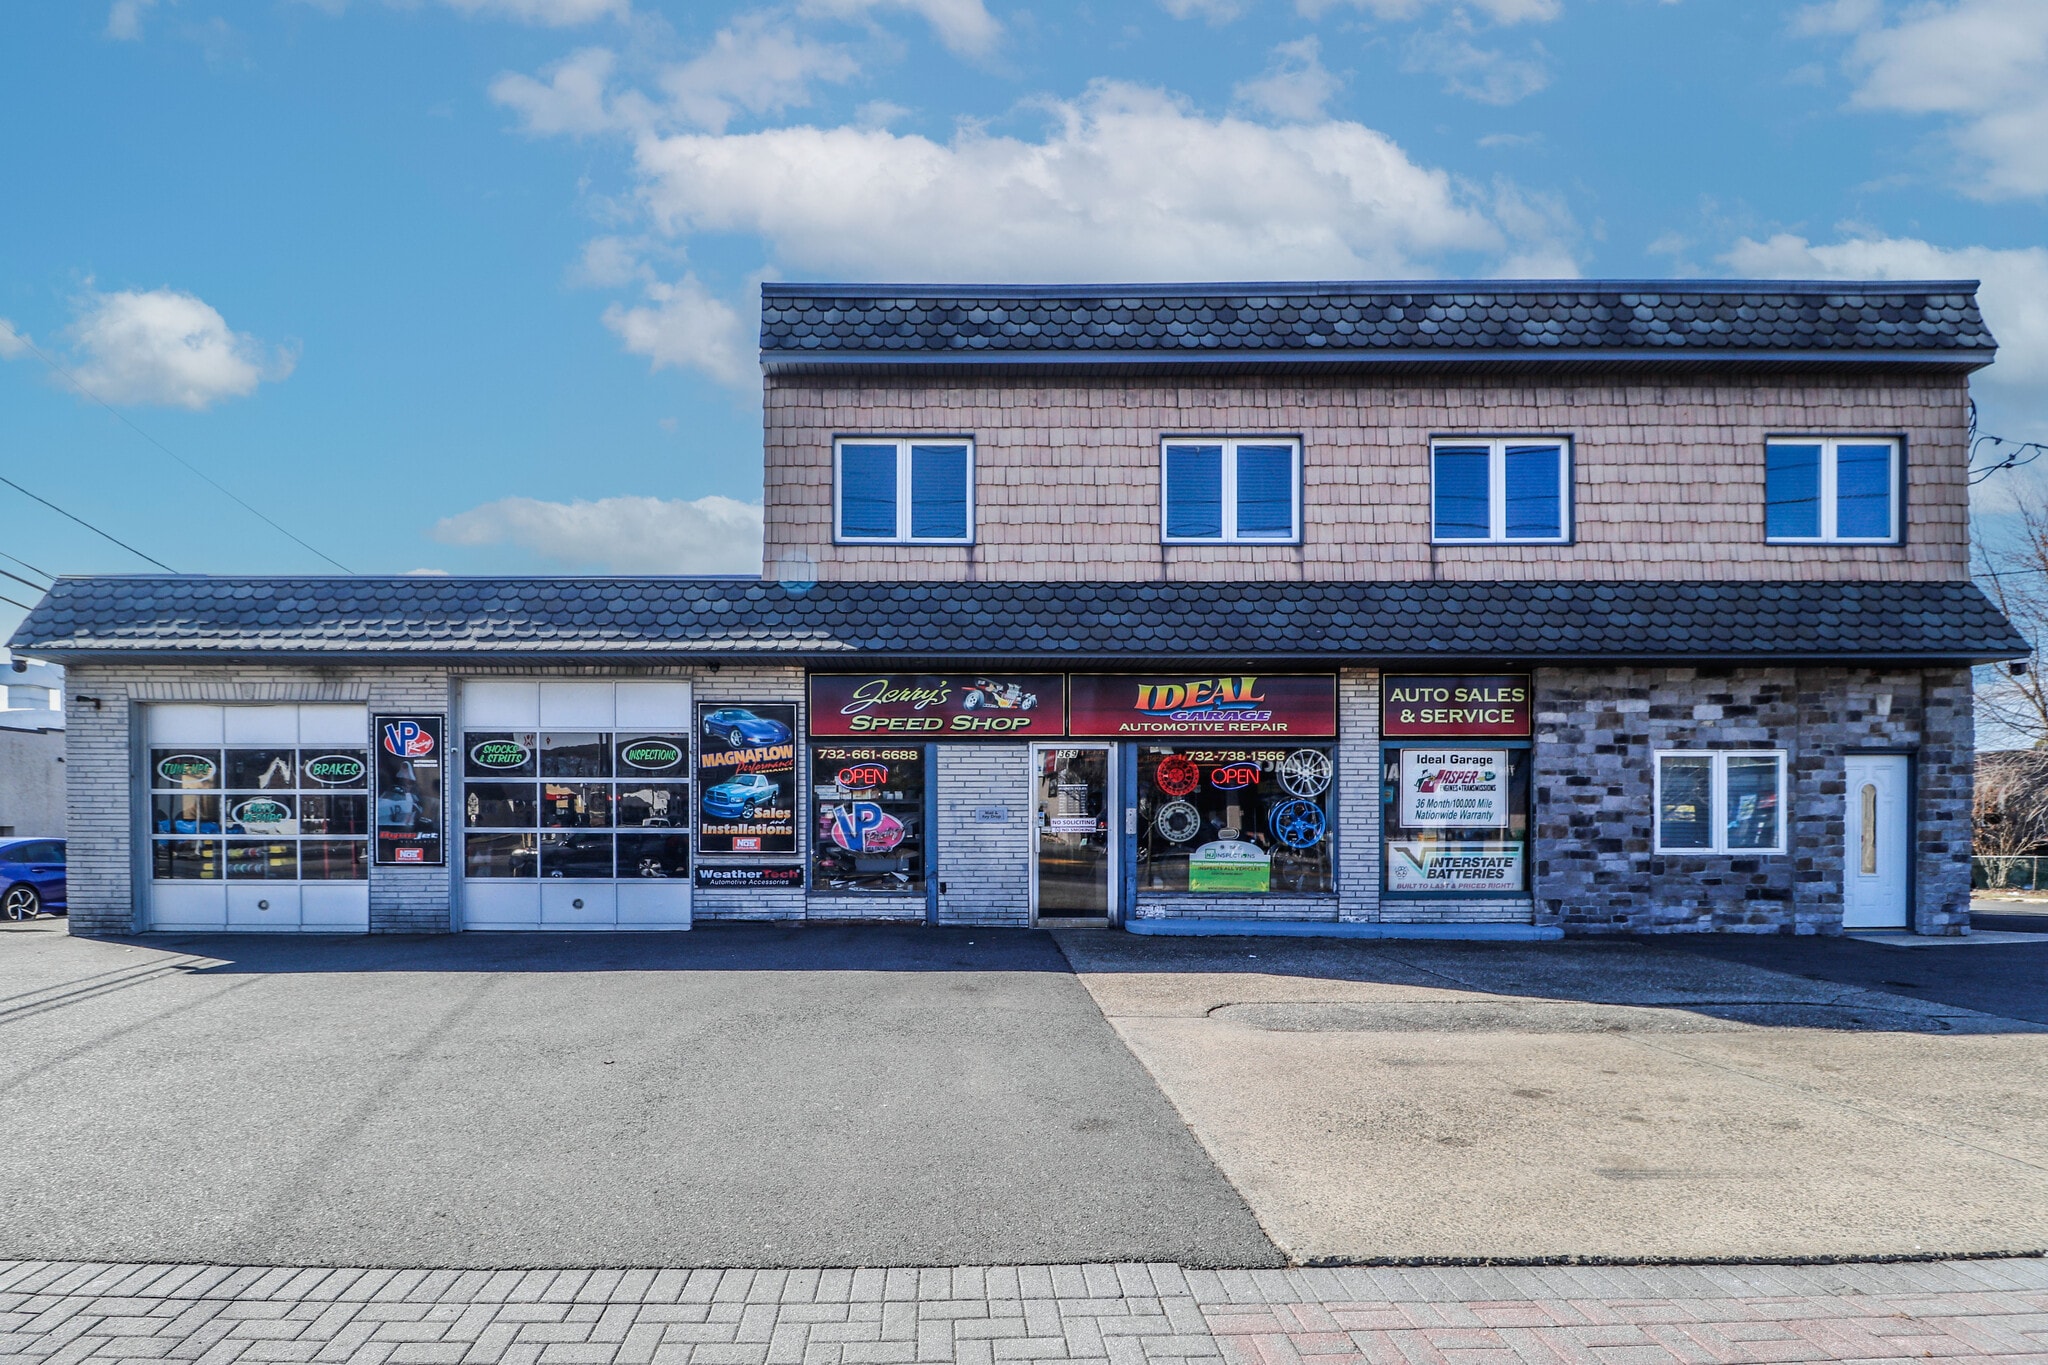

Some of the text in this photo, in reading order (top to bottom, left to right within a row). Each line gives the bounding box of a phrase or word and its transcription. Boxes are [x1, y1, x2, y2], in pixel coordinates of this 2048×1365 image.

[840, 679, 952, 715] Jerry's
[1134, 677, 1266, 710] IDEAL
[1390, 688, 1525, 702] AUTO SALES
[1169, 710, 1273, 721] GARAGE
[1400, 709, 1515, 723] & SERVICE
[849, 715, 1031, 731] SPEED SHOP
[1118, 722, 1288, 732] AUTOMOTIVE REPAIR
[384, 721, 420, 757] VP
[483, 745, 519, 754] SHOCKS
[628, 749, 677, 761] INSPECTIONS
[818, 749, 918, 760] 732-661-6688
[1058, 750, 1078, 758] 369
[486, 754, 523, 763] STRUTS
[701, 745, 794, 768] MAGNAFLOW
[1186, 751, 1285, 761] 732-738-1566
[1417, 754, 1493, 767] Ideal Garage
[312, 763, 359, 775] BRAKES
[736, 759, 794, 775] Performance
[838, 768, 887, 784] OPEN
[1211, 768, 1260, 785] OPEN
[1420, 769, 1479, 793] JASPER
[1415, 799, 1425, 809] 36
[1477, 799, 1493, 809] Mile
[754, 807, 791, 819] Sales
[1414, 810, 1495, 822] Nationwide Warranty
[701, 823, 793, 835] Installations
[833, 801, 883, 852] VP
[1429, 857, 1514, 868] INTERSTATE
[700, 869, 798, 879] WeatherTech
[1427, 868, 1505, 879] BATTERIES
